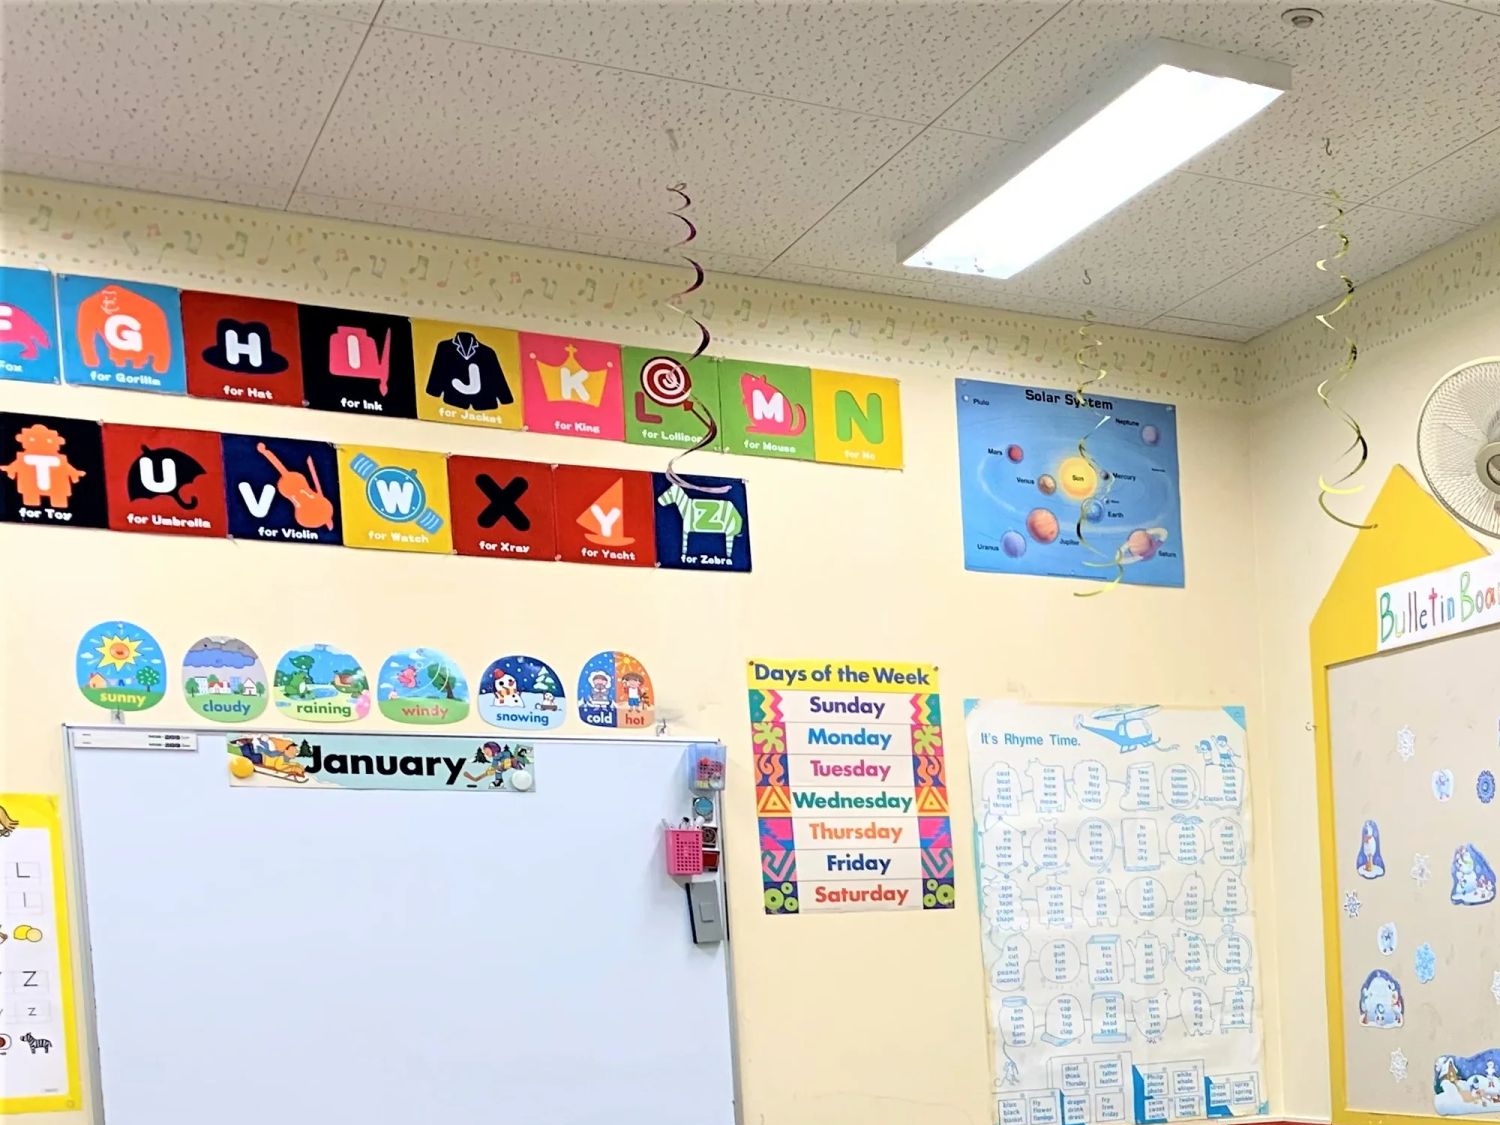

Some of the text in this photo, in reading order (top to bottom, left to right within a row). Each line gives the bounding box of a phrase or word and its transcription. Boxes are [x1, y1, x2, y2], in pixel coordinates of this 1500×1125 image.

[104, 314, 142, 352] G
[225, 329, 262, 367] H
[90, 371, 161, 386] for Gorilla
[451, 363, 482, 395] J
[559, 367, 590, 402] K
[223, 385, 273, 400] for Hat
[1025, 389, 1114, 411] Solar Sytem
[340, 397, 383, 411] for Ink
[634, 391, 663, 424] L
[752, 389, 784, 423] M
[438, 407, 503, 424] for Jacket
[834, 389, 884, 444] N
[1115, 418, 1140, 427] Neptune
[554, 420, 600, 434] for King
[641, 429, 658, 438] for
[743, 440, 796, 453] for Mouse
[988, 448, 1003, 456] Mars
[23, 454, 61, 491] T
[139, 456, 177, 493] U
[1016, 477, 1035, 485] Venus
[1113, 472, 1136, 481] Mercury
[238, 481, 276, 518] V
[375, 479, 415, 515] W
[475, 473, 531, 532] X
[19, 507, 73, 521] for Toy
[127, 513, 212, 529] for Umbrella
[590, 503, 621, 538] Y
[694, 500, 727, 531] Z
[258, 526, 319, 540] for Violin
[368, 530, 430, 544] for Watch
[479, 540, 499, 551] for
[581, 547, 636, 561] for Yacht
[977, 543, 999, 551] Uranus
[1158, 550, 1176, 558] Saturn
[681, 554, 733, 566] for Zebra
[1379, 587, 1455, 643] Bulletin
[754, 663, 930, 686] Days of the Week
[100, 690, 146, 708] sunny
[810, 696, 885, 719] Sunday
[202, 700, 251, 716] cloudy
[296, 702, 352, 718] raining
[402, 704, 449, 720] windy
[496, 711, 549, 727] snowing
[587, 711, 613, 725] cold
[625, 713, 645, 726] hot
[808, 728, 892, 750] Monday
[981, 732, 1081, 747] It's Rhyme Time.
[305, 744, 468, 786] January
[810, 759, 891, 782] Tuesday
[792, 791, 913, 813] Wednesday
[809, 822, 903, 844] Thursday
[826, 853, 891, 875] Friday
[815, 886, 909, 906] Saturday
[22, 970, 38, 987] Z
